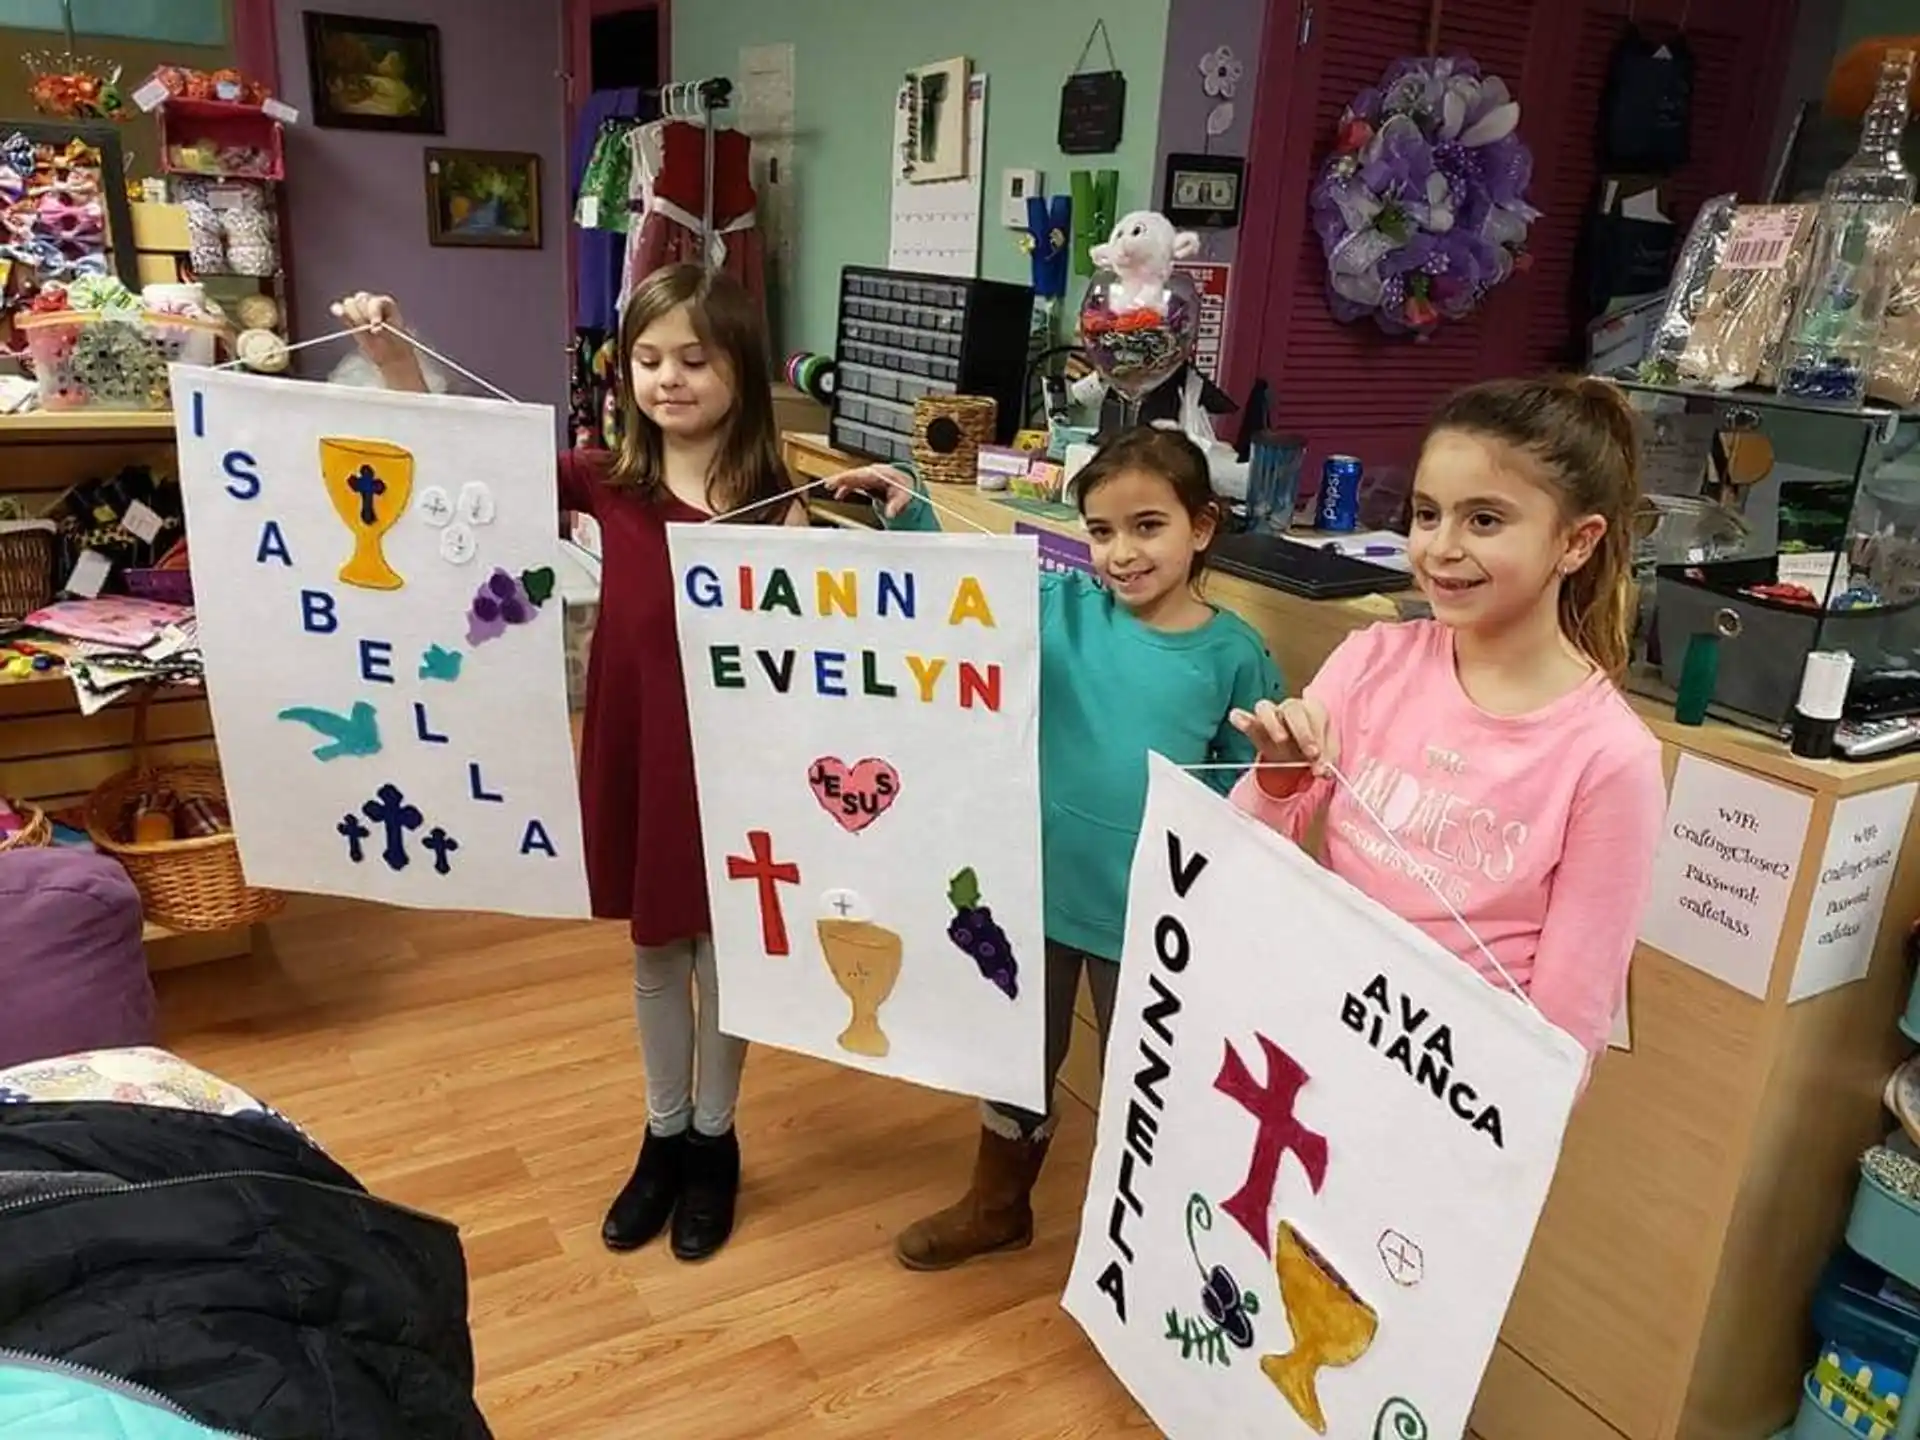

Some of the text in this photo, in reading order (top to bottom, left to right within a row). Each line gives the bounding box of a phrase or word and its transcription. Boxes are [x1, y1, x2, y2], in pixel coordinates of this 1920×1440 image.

[193, 391, 558, 858] ISABELLA
[708, 645, 1001, 712] EVELYN
[809, 764, 894, 816] JESUS
[1096, 829, 1209, 1325] VOZZELLA
[1341, 991, 1504, 1149] BIANCA
[1363, 973, 1455, 1069] AVA
